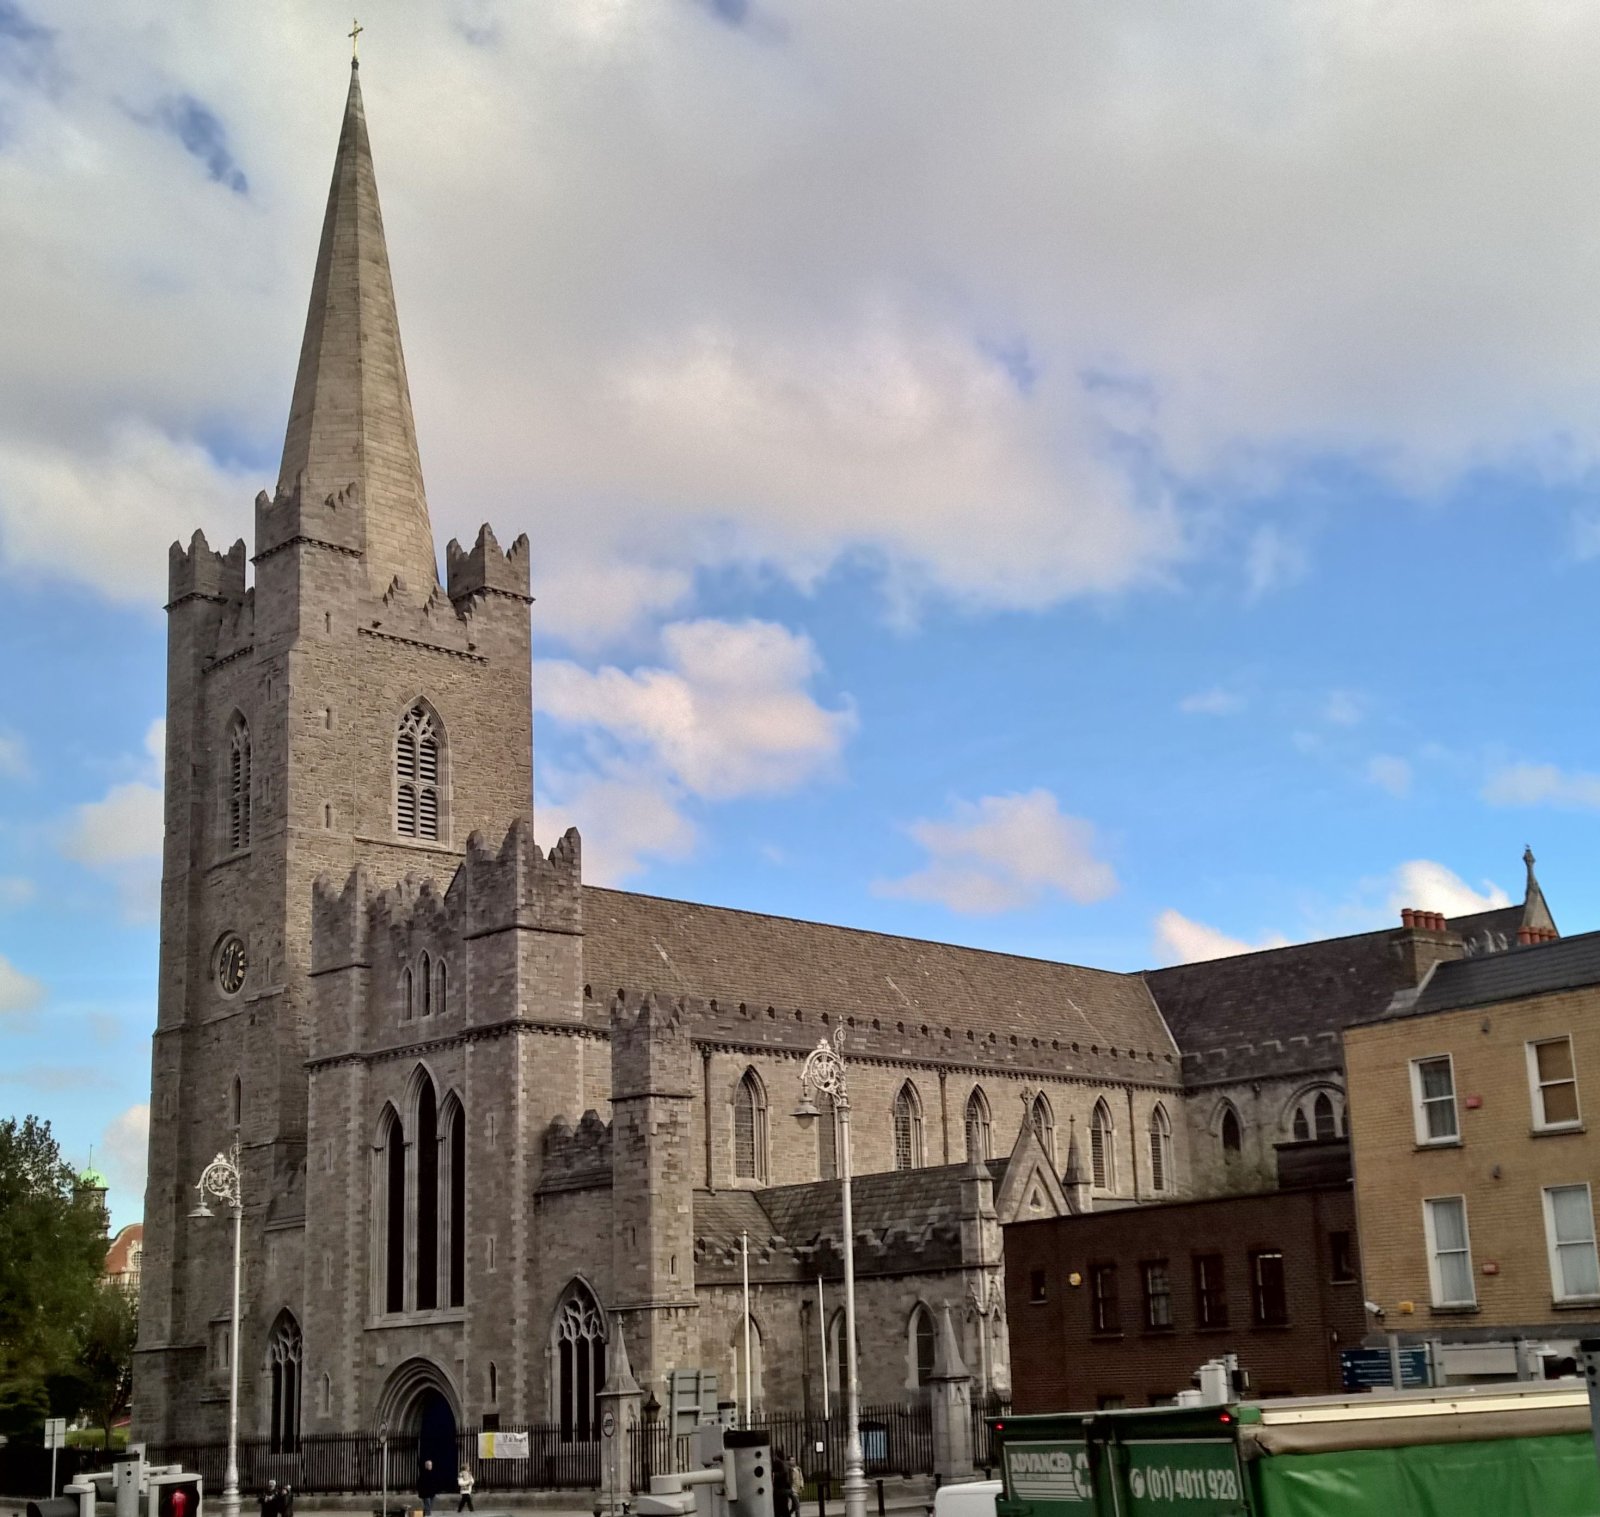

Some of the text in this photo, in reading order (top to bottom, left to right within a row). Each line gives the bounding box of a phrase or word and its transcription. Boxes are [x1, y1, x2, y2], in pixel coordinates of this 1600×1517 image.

[1010, 1453, 1072, 1472] ADVANCED
[1146, 1465, 1174, 1502] (01)
[1207, 1469, 1238, 1500] 928
